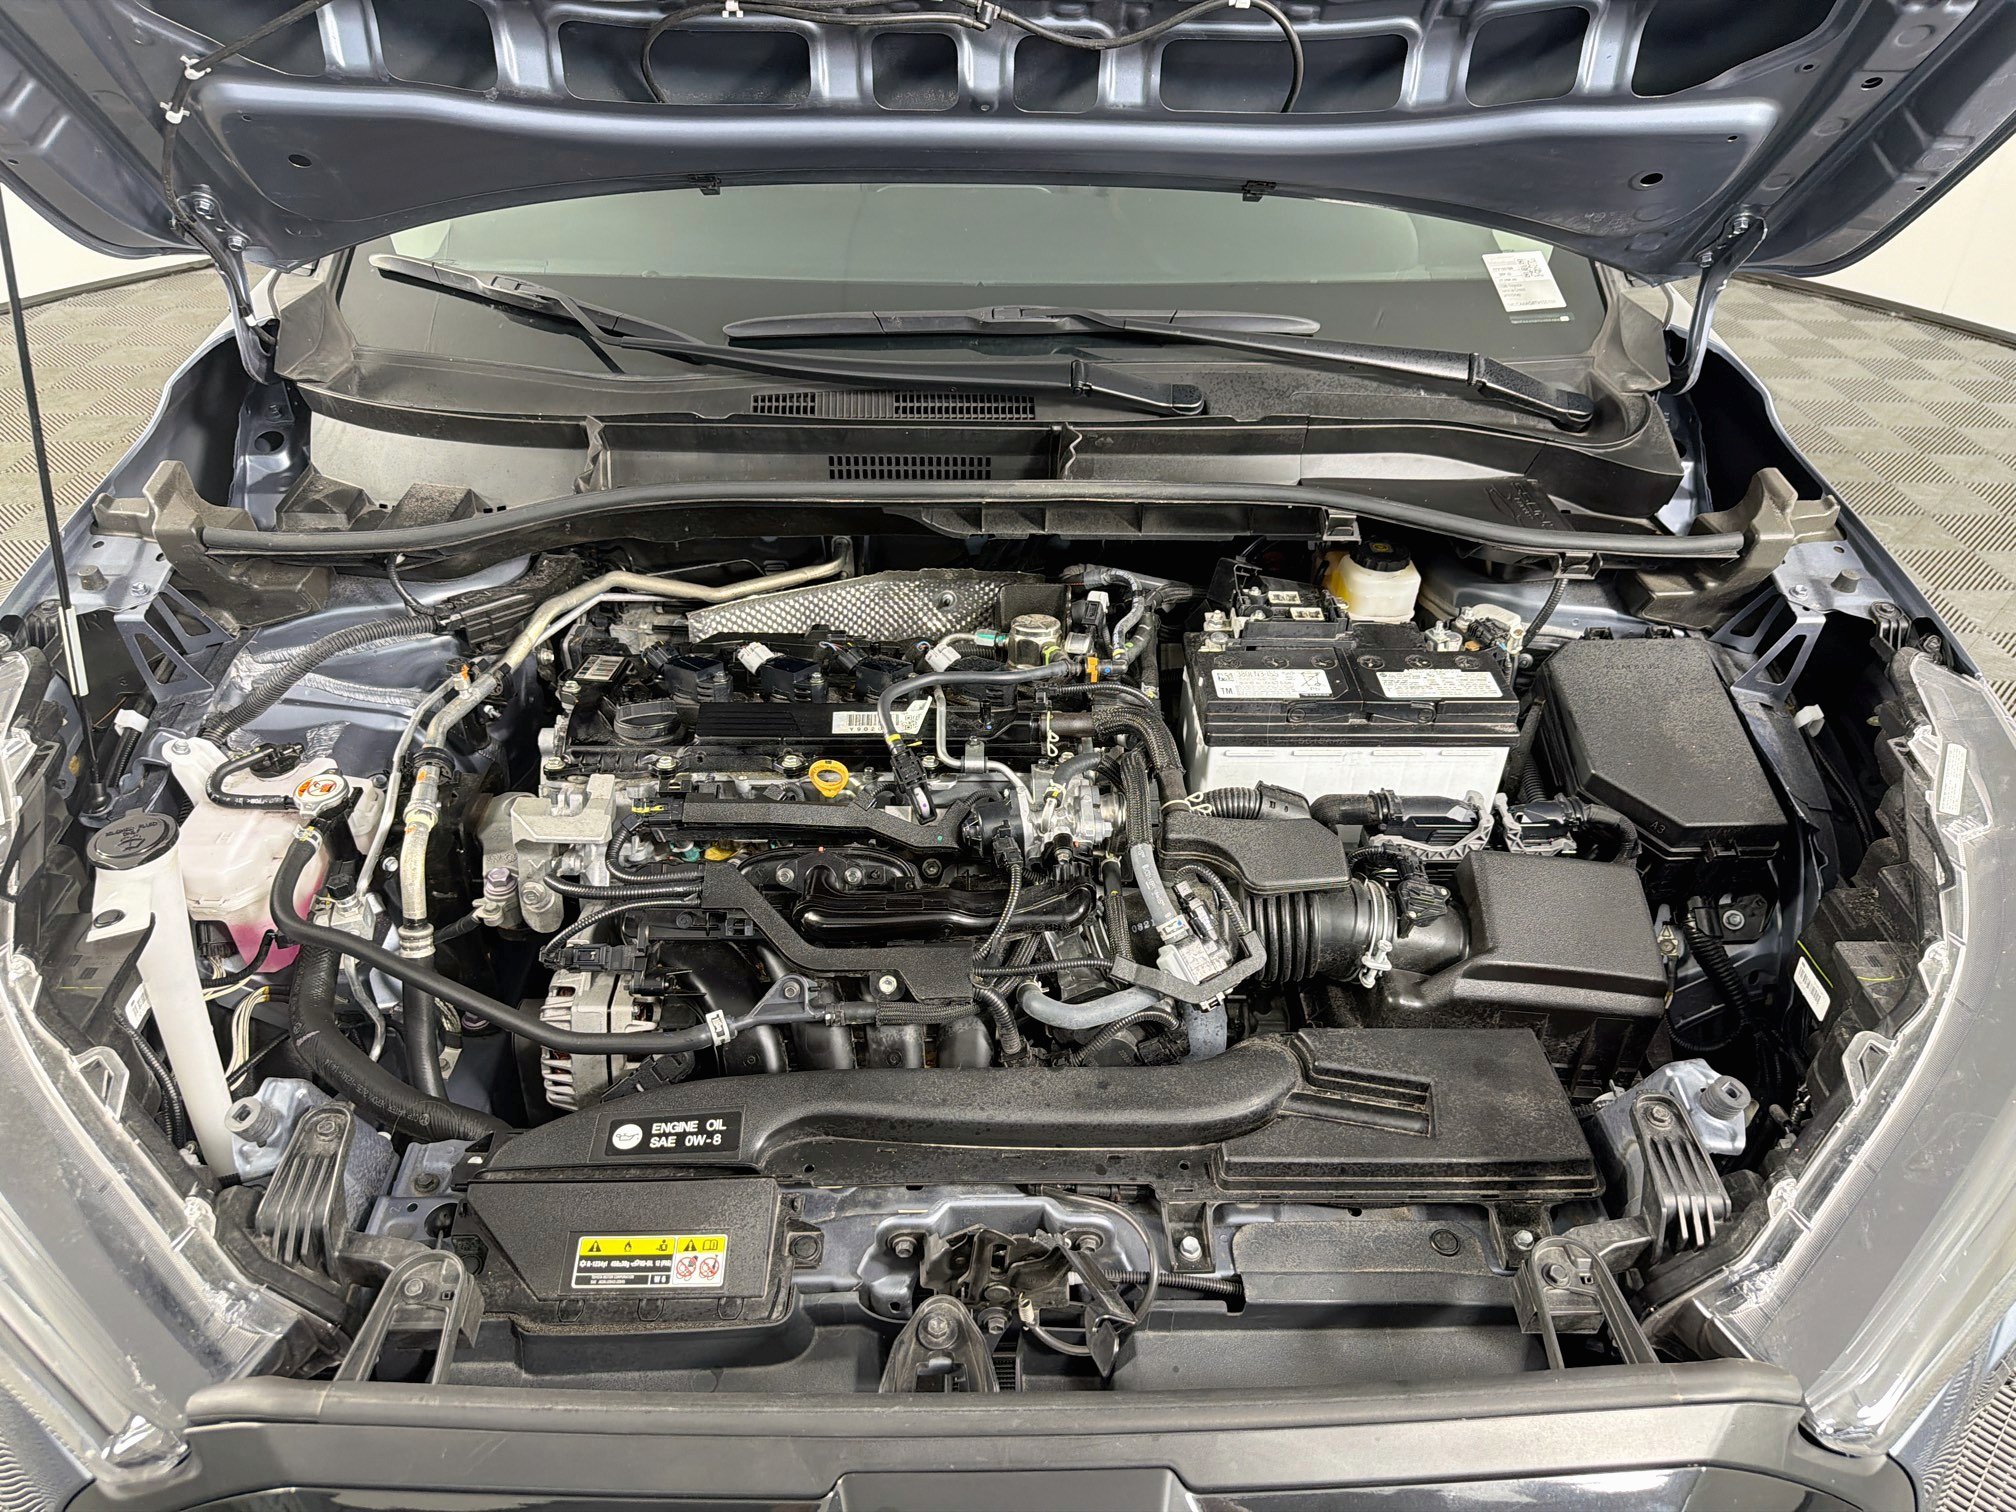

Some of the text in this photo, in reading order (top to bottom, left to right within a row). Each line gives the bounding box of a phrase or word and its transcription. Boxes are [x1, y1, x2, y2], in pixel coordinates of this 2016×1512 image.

[1650, 821, 1666, 834] A3
[652, 1119, 727, 1134] ENGINE OIL
[649, 1133, 722, 1148] SAE 0W-8
